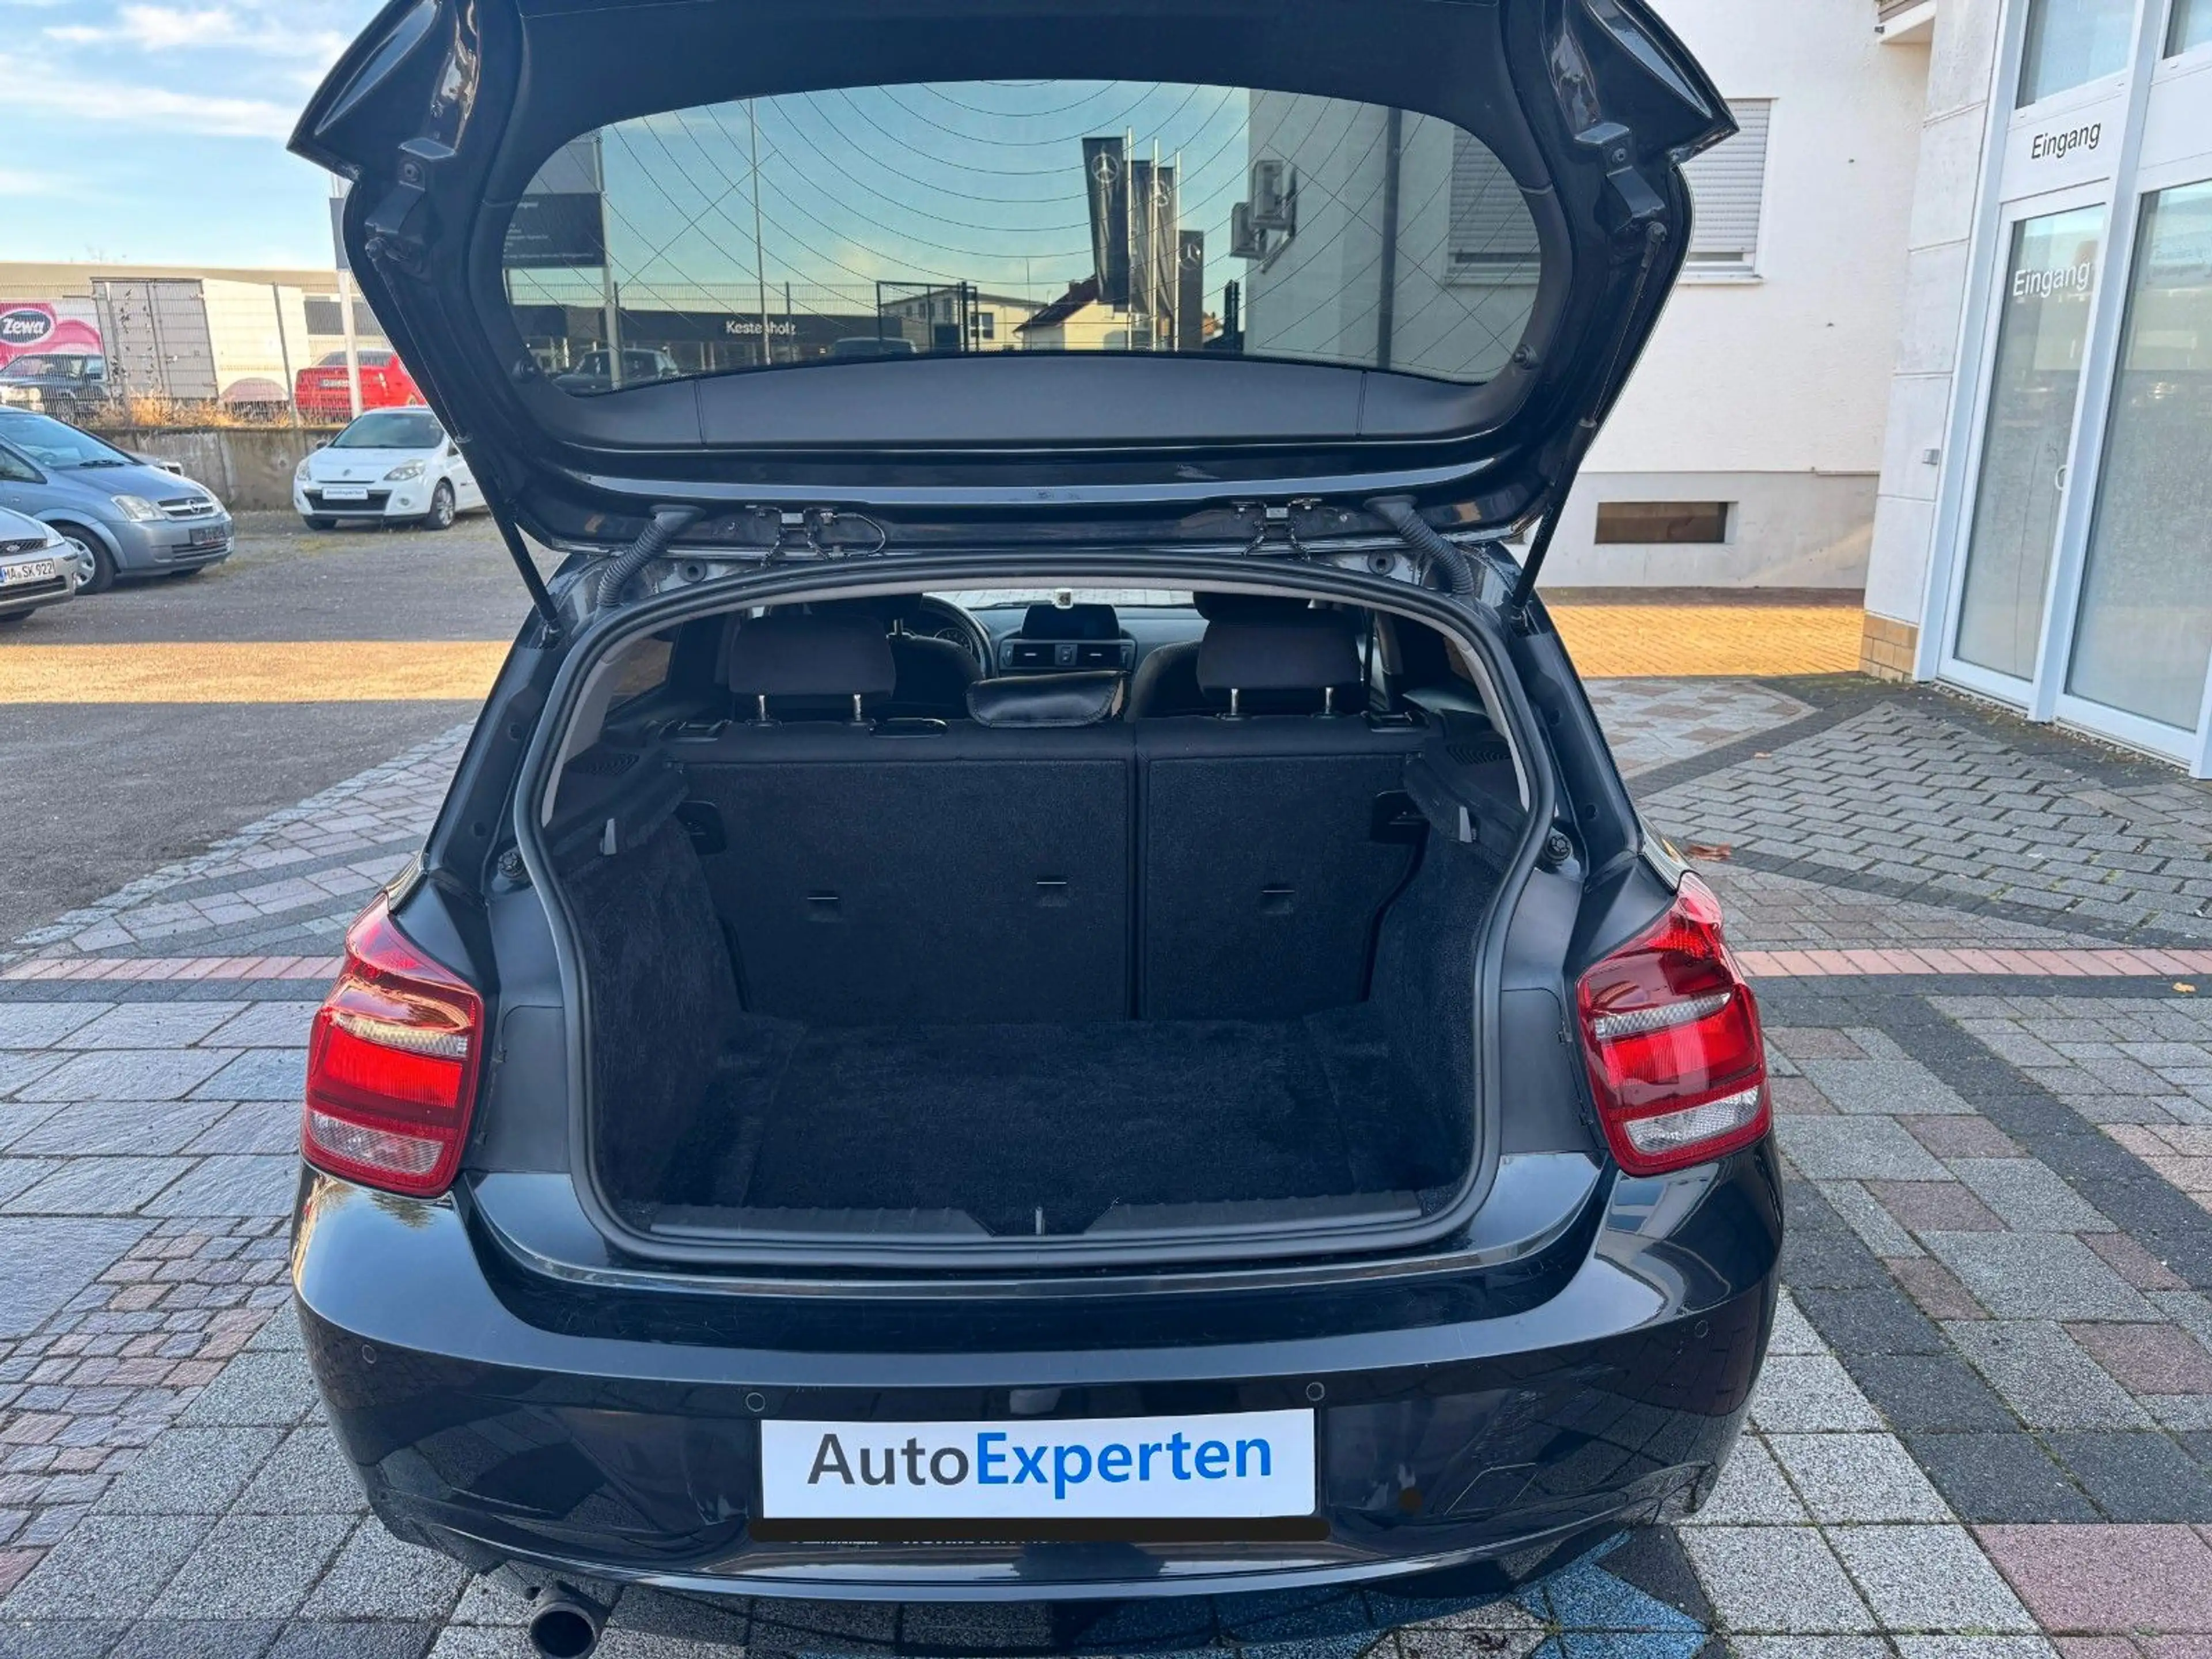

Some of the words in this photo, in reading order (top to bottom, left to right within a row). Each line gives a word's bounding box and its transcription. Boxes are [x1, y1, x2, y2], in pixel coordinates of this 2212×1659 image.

[2032, 123, 2101, 159] Eingang
[2013, 261, 2090, 298] Eingang
[2, 317, 44, 334] Zewa
[22, 565, 35, 577] SK
[808, 1433, 1271, 1499] AutoExperten
